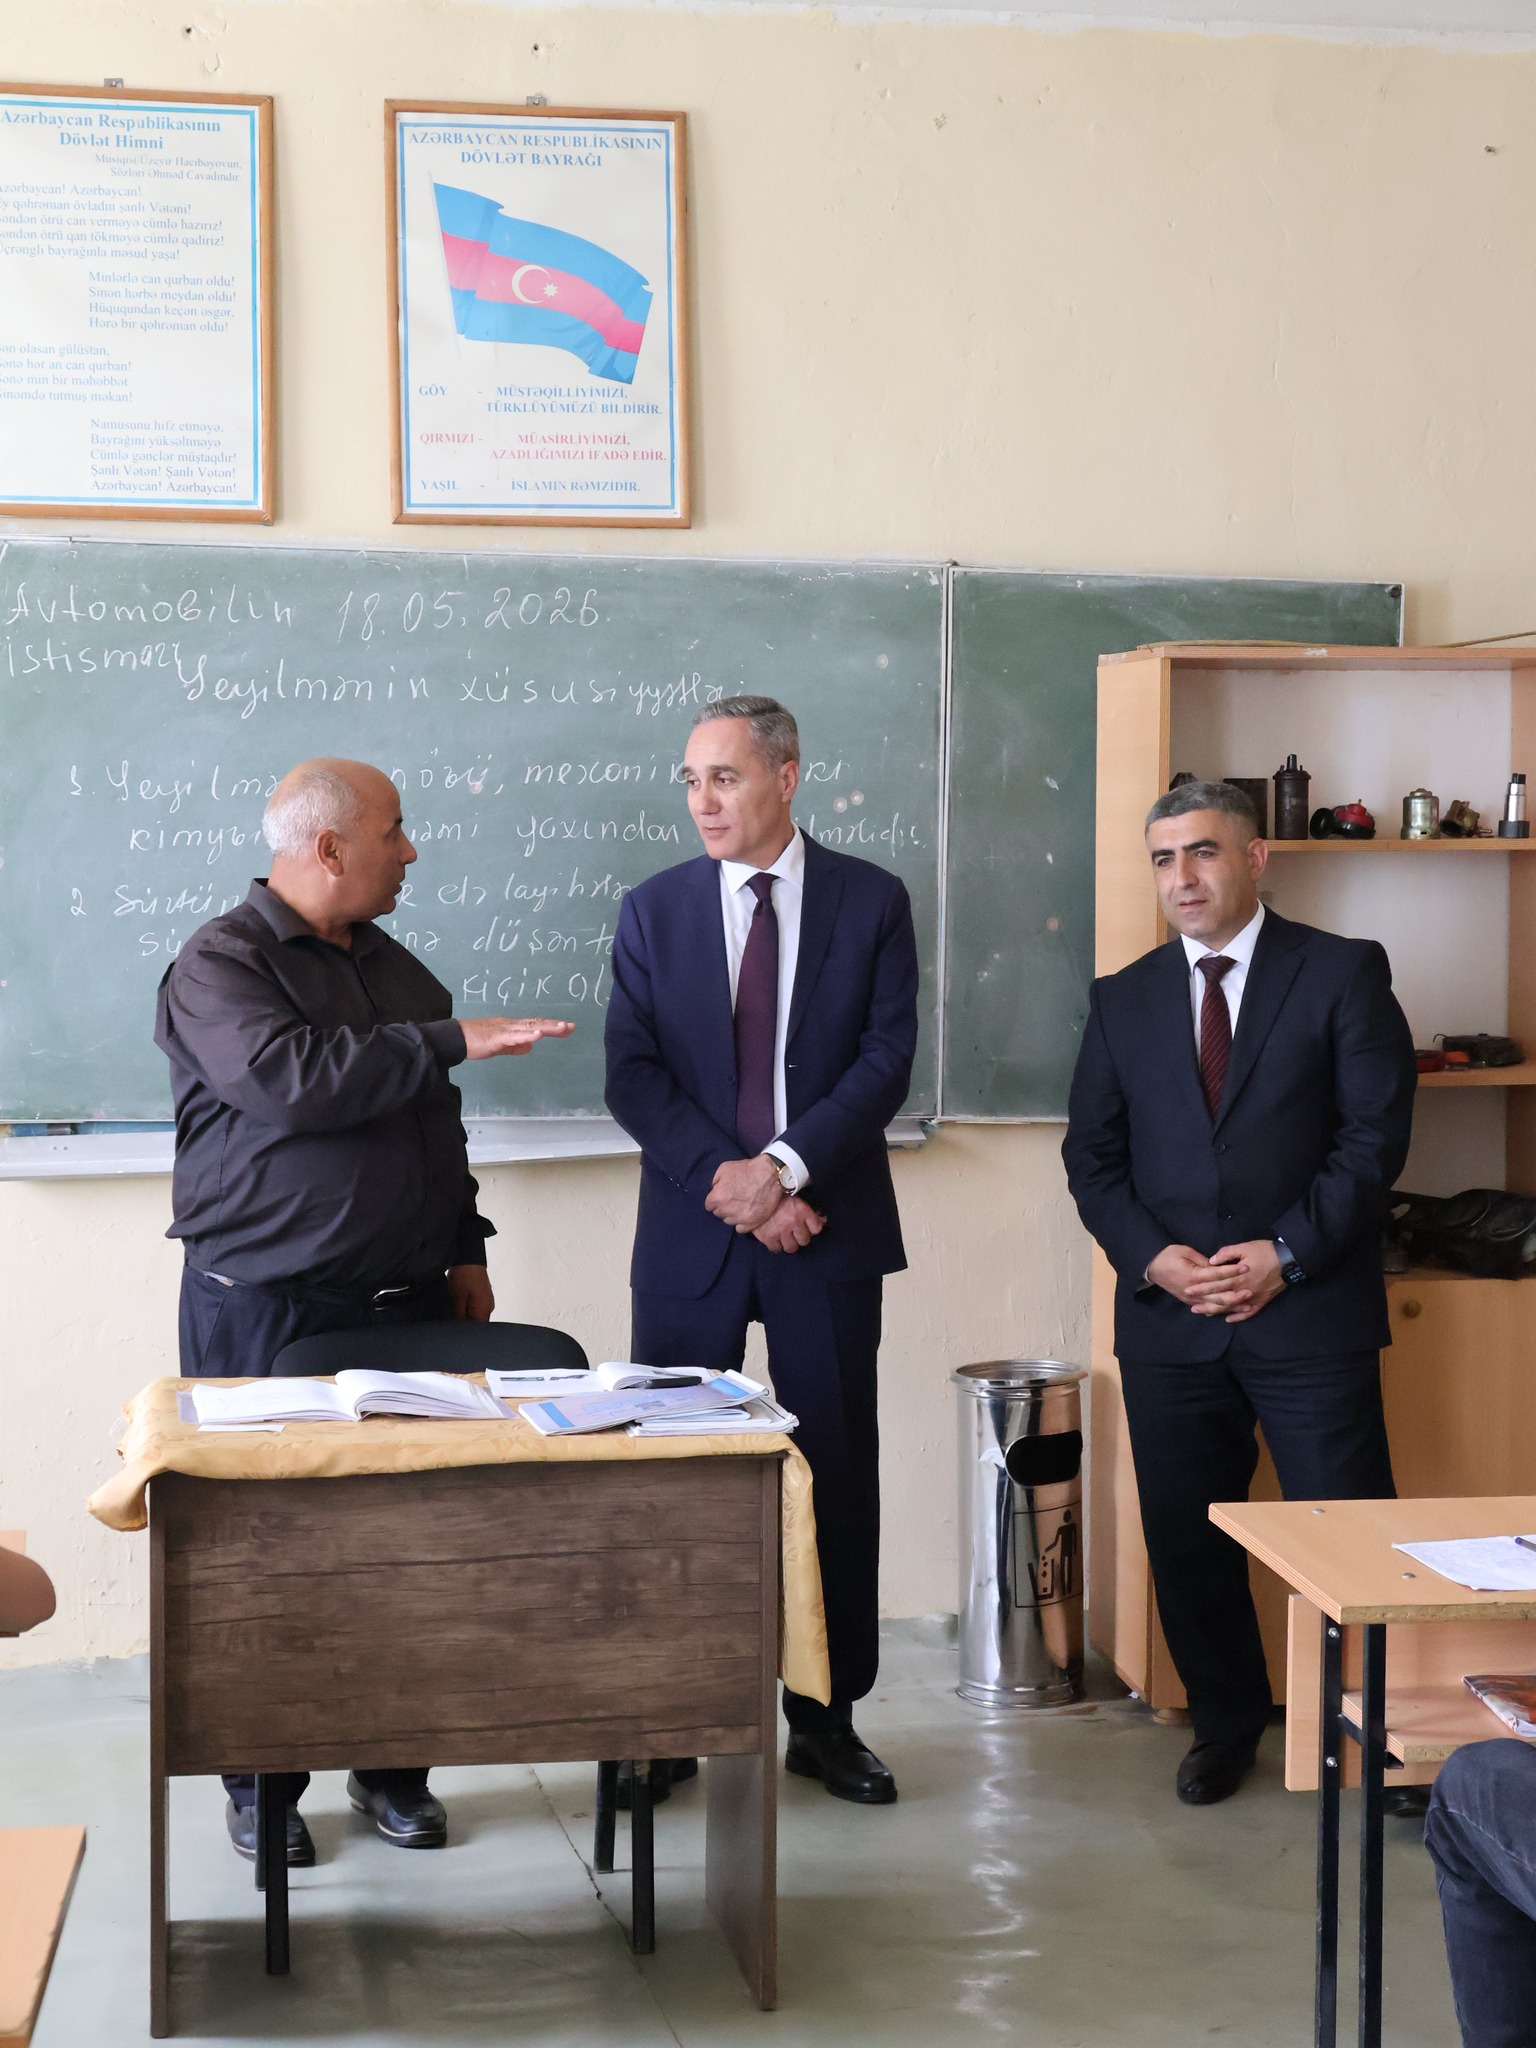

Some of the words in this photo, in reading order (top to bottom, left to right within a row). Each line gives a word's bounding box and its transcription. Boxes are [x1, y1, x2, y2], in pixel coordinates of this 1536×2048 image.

[1, 110, 92, 128] Azərbaycan
[99, 114, 220, 132] Respublikasının
[60, 132, 109, 147] Dövlət
[116, 134, 163, 149] Himni
[409, 132, 517, 146] AZƏRBAYCAN
[523, 134, 662, 150] RESPUBLİKASININ
[140, 153, 172, 167] Üzeyir
[462, 150, 526, 165] DÖVLƏT
[532, 152, 602, 166] BAYRAĞI
[111, 168, 144, 178] Sözləri
[148, 168, 183, 180] Əhməd
[70, 185, 141, 198] Azərbaycan!
[13, 199, 69, 212] qəhrəman
[74, 200, 115, 212] övladın
[119, 202, 144, 214] şanlı
[41, 215, 63, 226] ötrü
[90, 219, 139, 230] verməyə
[143, 217, 177, 229] cümlə
[181, 218, 222, 231] hazırız!
[41, 230, 63, 241] ötrü
[67, 233, 86, 244] qan
[90, 231, 140, 246] tökməyə
[144, 232, 178, 244] cümlə
[182, 234, 224, 247] qadiriz!
[48, 244, 106, 259] bayrağınla
[110, 247, 147, 259] məsud
[151, 249, 179, 262] yaşa!
[89, 272, 137, 284] Minlərlə
[142, 276, 160, 284] can
[165, 273, 202, 288] qurban
[207, 275, 235, 287] oldu!
[89, 287, 120, 298] Sinən
[125, 288, 156, 299] hərbə
[161, 289, 203, 303] meydan
[208, 291, 236, 303] oldu!
[90, 302, 160, 316] Hüququndan
[165, 304, 196, 319] keçən
[90, 317, 117, 328] Hərə
[122, 318, 136, 329] bir
[140, 319, 195, 334] qəhrəman
[200, 321, 228, 332] oldu!
[20, 343, 55, 355] olasan
[27, 359, 45, 370] hər
[49, 362, 62, 370] an
[66, 362, 85, 371] can
[89, 361, 131, 374] qurban!
[27, 375, 48, 385] min
[53, 375, 67, 386] bir
[72, 375, 128, 387] məhəbbət
[49, 390, 87, 403] tutmuş
[91, 391, 132, 402] məkan!
[419, 383, 448, 396] GÖY
[486, 401, 596, 414] TÜRKLÜYÜMÜZÜ
[601, 402, 662, 415] BİLDİRİR.
[91, 418, 150, 431] Namusunu
[154, 420, 175, 432] hifz
[91, 434, 145, 447] Bayrağını
[149, 435, 220, 450] yüksəltməyə
[420, 433, 474, 446] QIRMIZI
[518, 432, 630, 446] MÜASİRLİYİMİZİ,
[91, 450, 128, 461] Cümlə
[132, 451, 173, 464] gənclər
[178, 452, 236, 466] müştaqdır!
[490, 448, 584, 460] AZADLIĞIMIZI
[589, 448, 629, 461] İFADƏ
[633, 449, 666, 461] EDİR.
[91, 465, 119, 478] Şanlı
[124, 465, 161, 477] Vətən!
[166, 466, 193, 479] Şanlı
[198, 467, 235, 478] Vətən!
[91, 480, 161, 494] Azərbaycan!
[167, 481, 236, 495] Azərbaycan!
[421, 480, 459, 492] YAŞIL
[512, 480, 566, 492] İSLAMIN
[570, 480, 640, 492] RƏMZİDİR.
[106, 759, 282, 813] Yeyilmə
